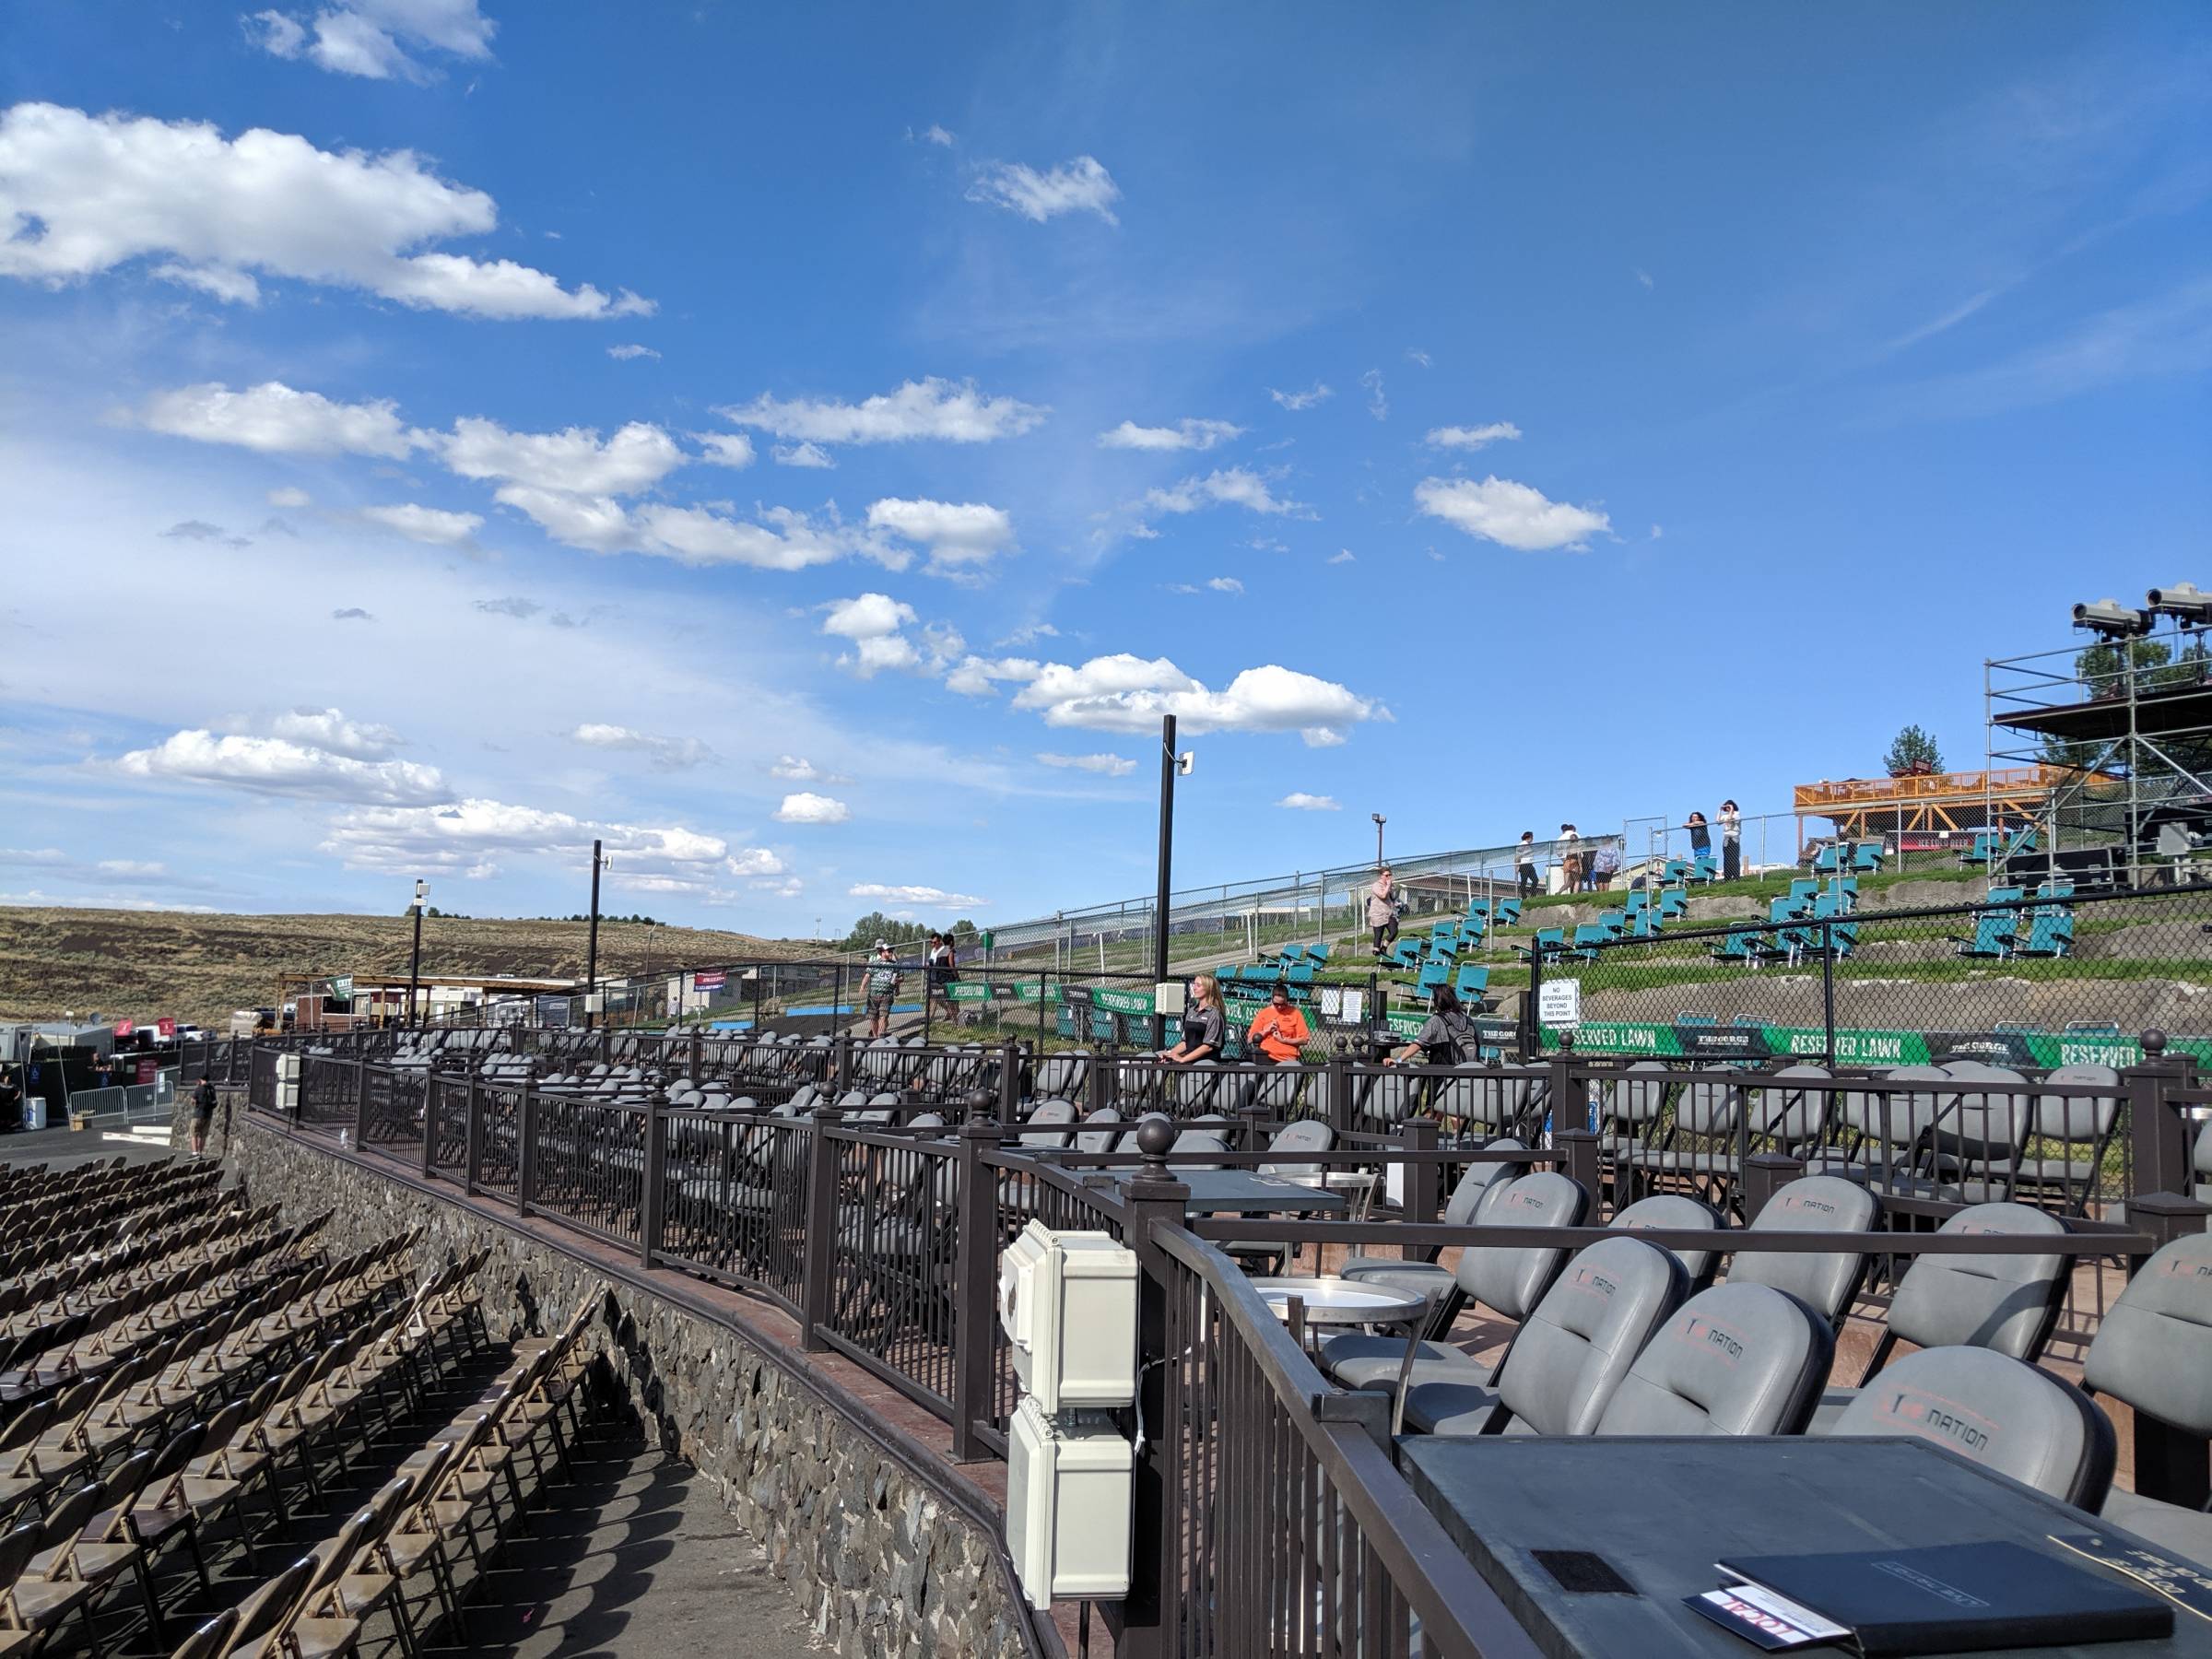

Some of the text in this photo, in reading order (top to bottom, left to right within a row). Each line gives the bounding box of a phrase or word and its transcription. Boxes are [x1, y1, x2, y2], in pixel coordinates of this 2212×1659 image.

[1622, 1029, 1655, 1048] LAWN
[1861, 1037, 1900, 1058] LAWN
[2061, 1043, 2136, 1067] RESERVED
[1926, 1408, 1989, 1452] NATION
[1721, 1597, 1794, 1637] LOCAL
